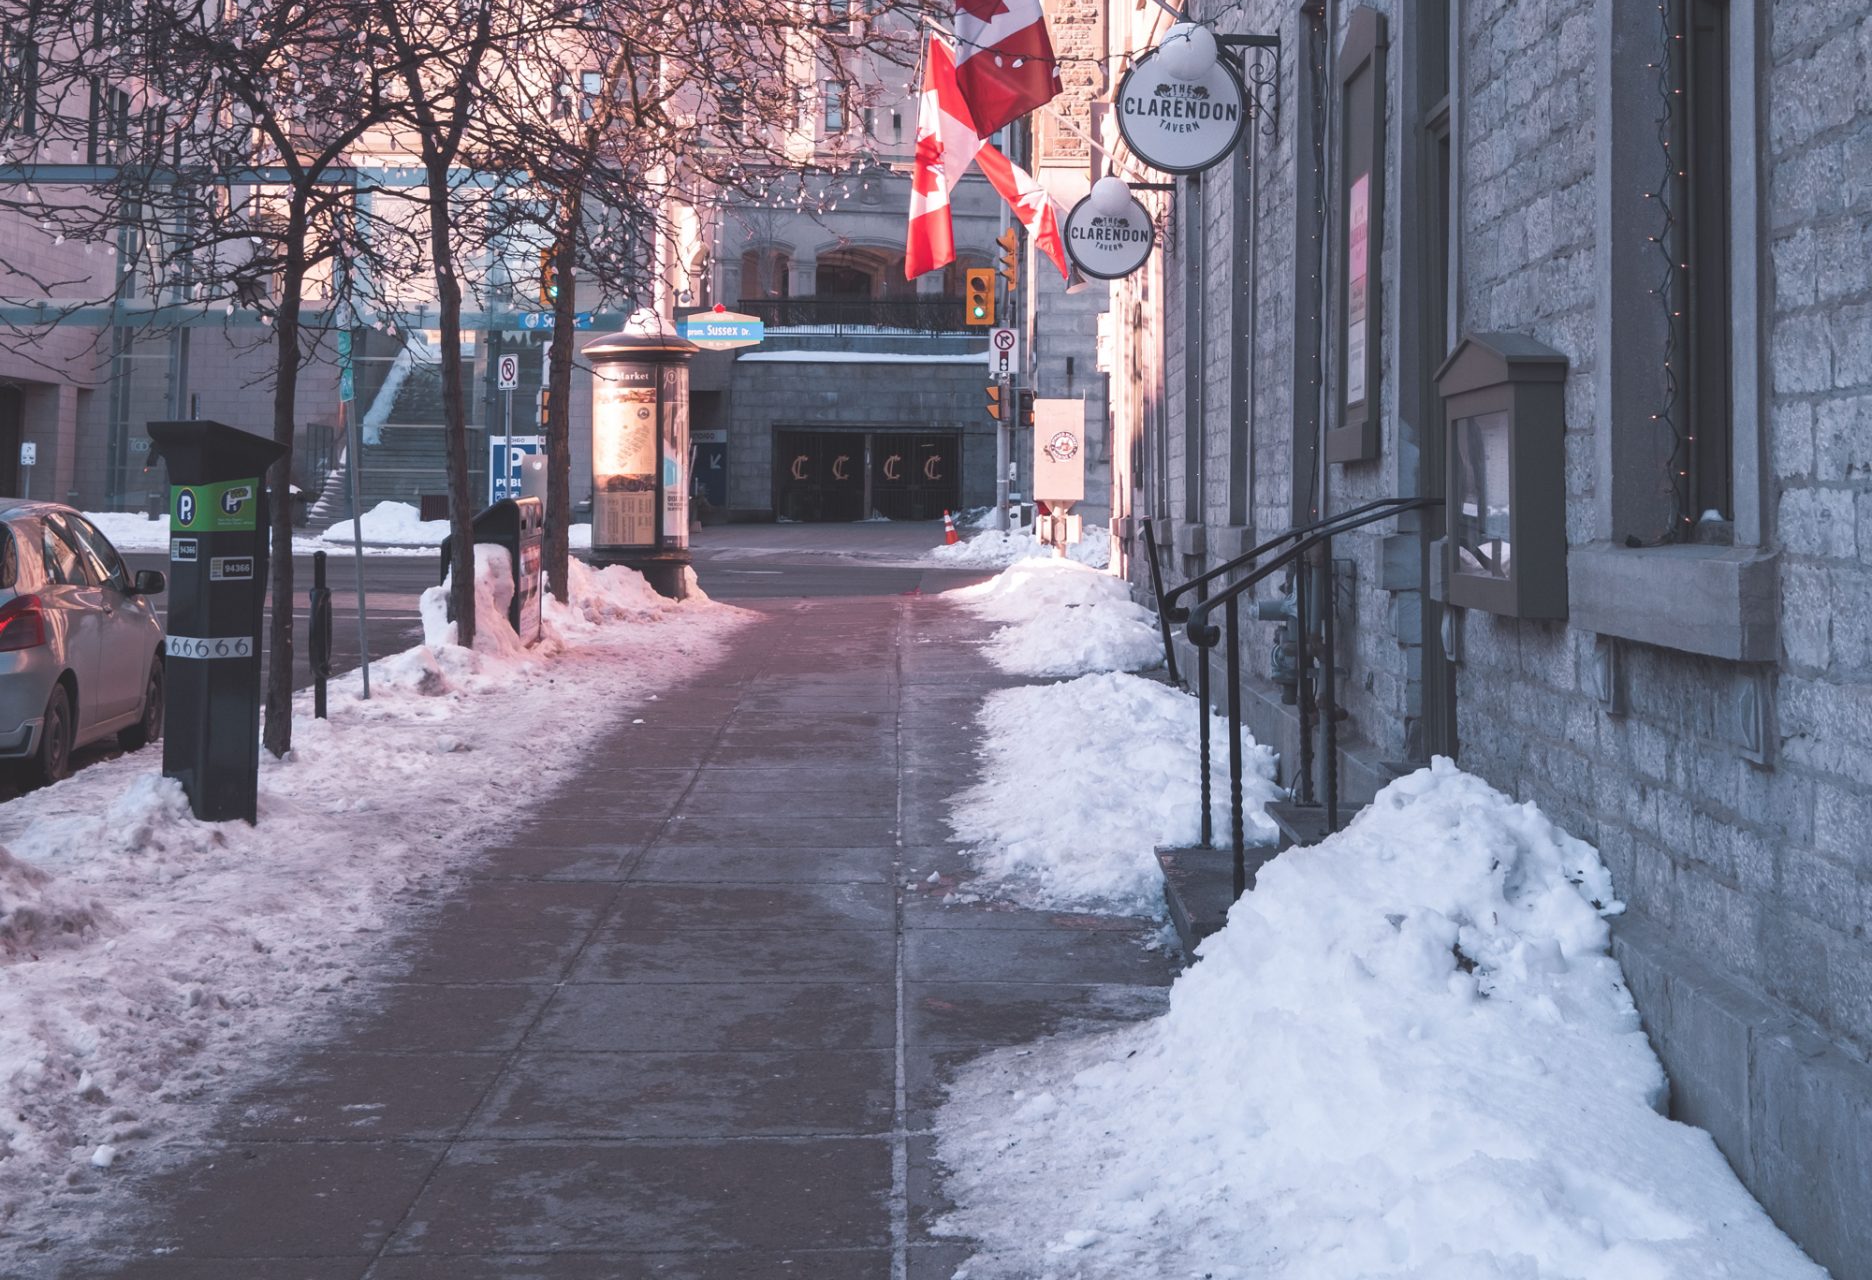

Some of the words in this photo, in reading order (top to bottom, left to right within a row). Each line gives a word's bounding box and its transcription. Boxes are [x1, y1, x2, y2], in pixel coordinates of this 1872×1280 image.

[1172, 84, 1193, 95] THE
[1124, 97, 1237, 121] CLARENDON
[1160, 119, 1200, 133] TAVERN
[1071, 227, 1148, 242] CLARENDON
[1095, 242, 1123, 251] TAVERN
[707, 324, 738, 336] Sussex
[224, 564, 250, 573] 94366
